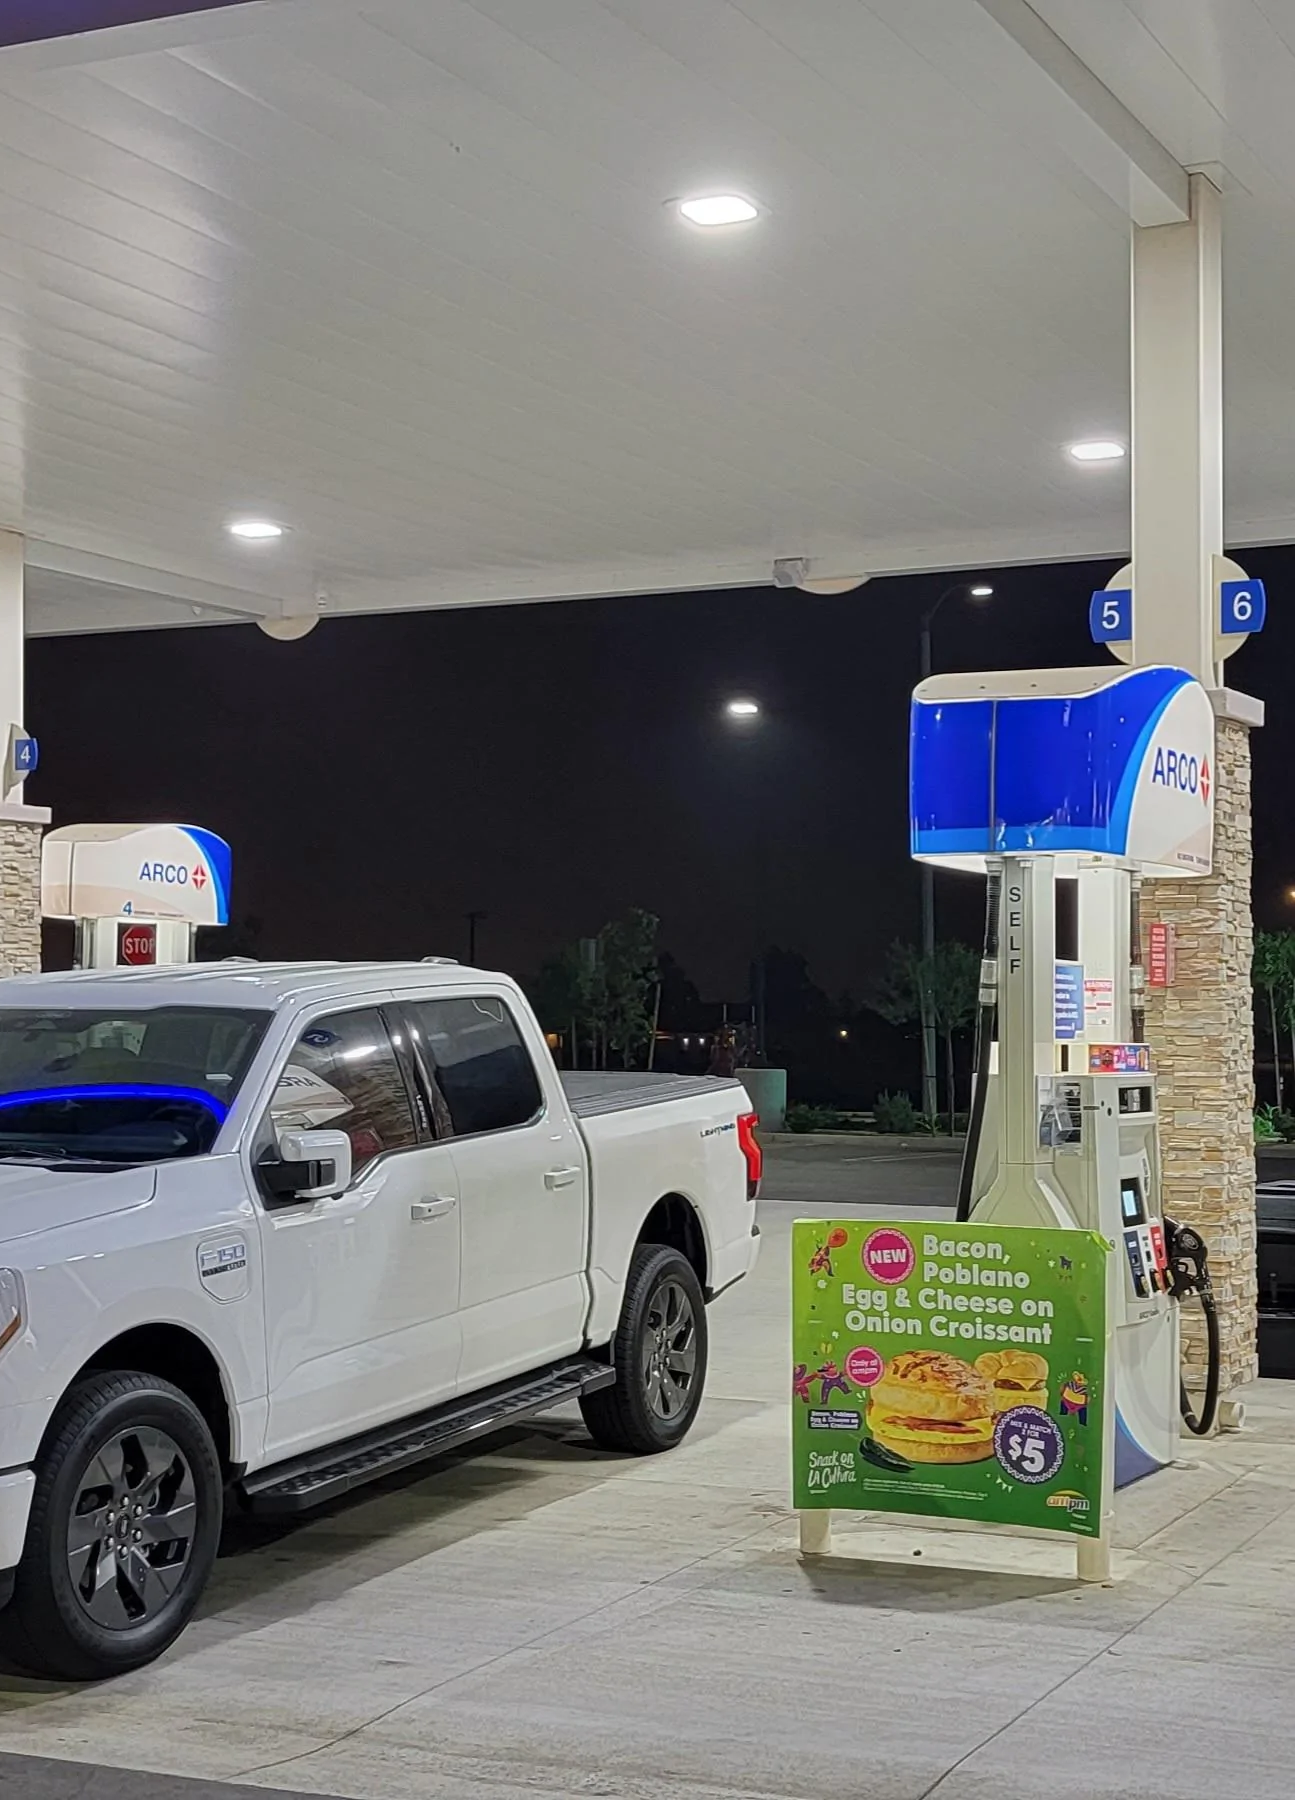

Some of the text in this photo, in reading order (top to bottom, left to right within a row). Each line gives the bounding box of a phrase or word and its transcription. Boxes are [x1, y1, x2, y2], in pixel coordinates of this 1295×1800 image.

[1101, 600, 1120, 630] 5
[1232, 591, 1252, 621] 6
[20, 745, 31, 763] 4
[1152, 747, 1198, 794] ARCO
[139, 862, 188, 884] ARCO
[123, 901, 132, 915] 4
[1009, 887, 1021, 974] SELF
[869, 1249, 907, 1265] NEW
[922, 1234, 1011, 1265] Bacon,
[923, 1261, 1031, 1289] Poblano
[842, 1283, 1054, 1318] Egg & Cheese on
[844, 1310, 1052, 1345] Onion Croissant
[1021, 1428, 1040, 1438] 2 FOR
[1029, 1423, 1052, 1435] MATCH
[809, 1450, 855, 1469] Snack on
[1008, 1434, 1045, 1473] $5
[821, 1466, 857, 1489] Cultura
[1047, 1496, 1090, 1512] ampm
